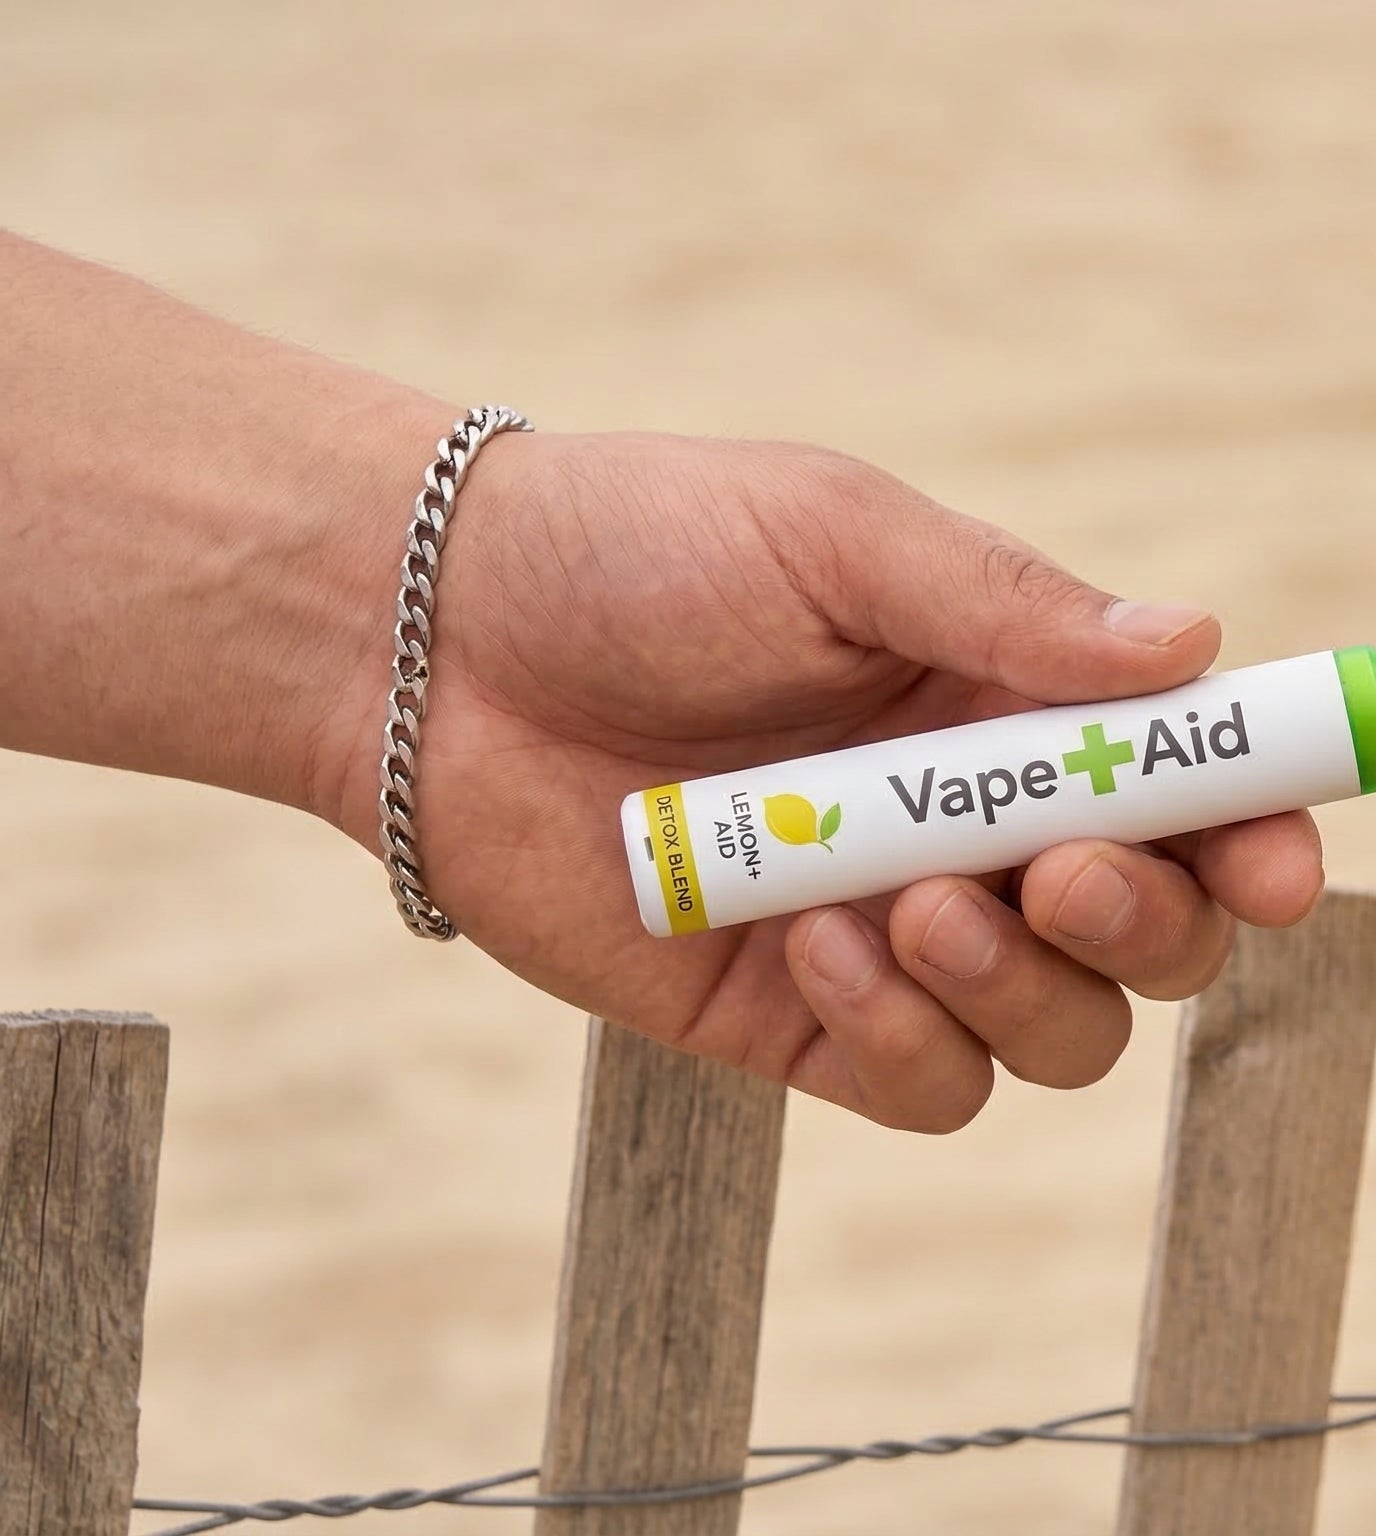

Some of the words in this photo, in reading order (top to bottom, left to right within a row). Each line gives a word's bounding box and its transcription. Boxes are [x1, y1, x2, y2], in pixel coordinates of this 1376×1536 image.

[656, 795, 680, 849] DETOX
[668, 852, 694, 913] BLEND
[714, 821, 736, 859] AID
